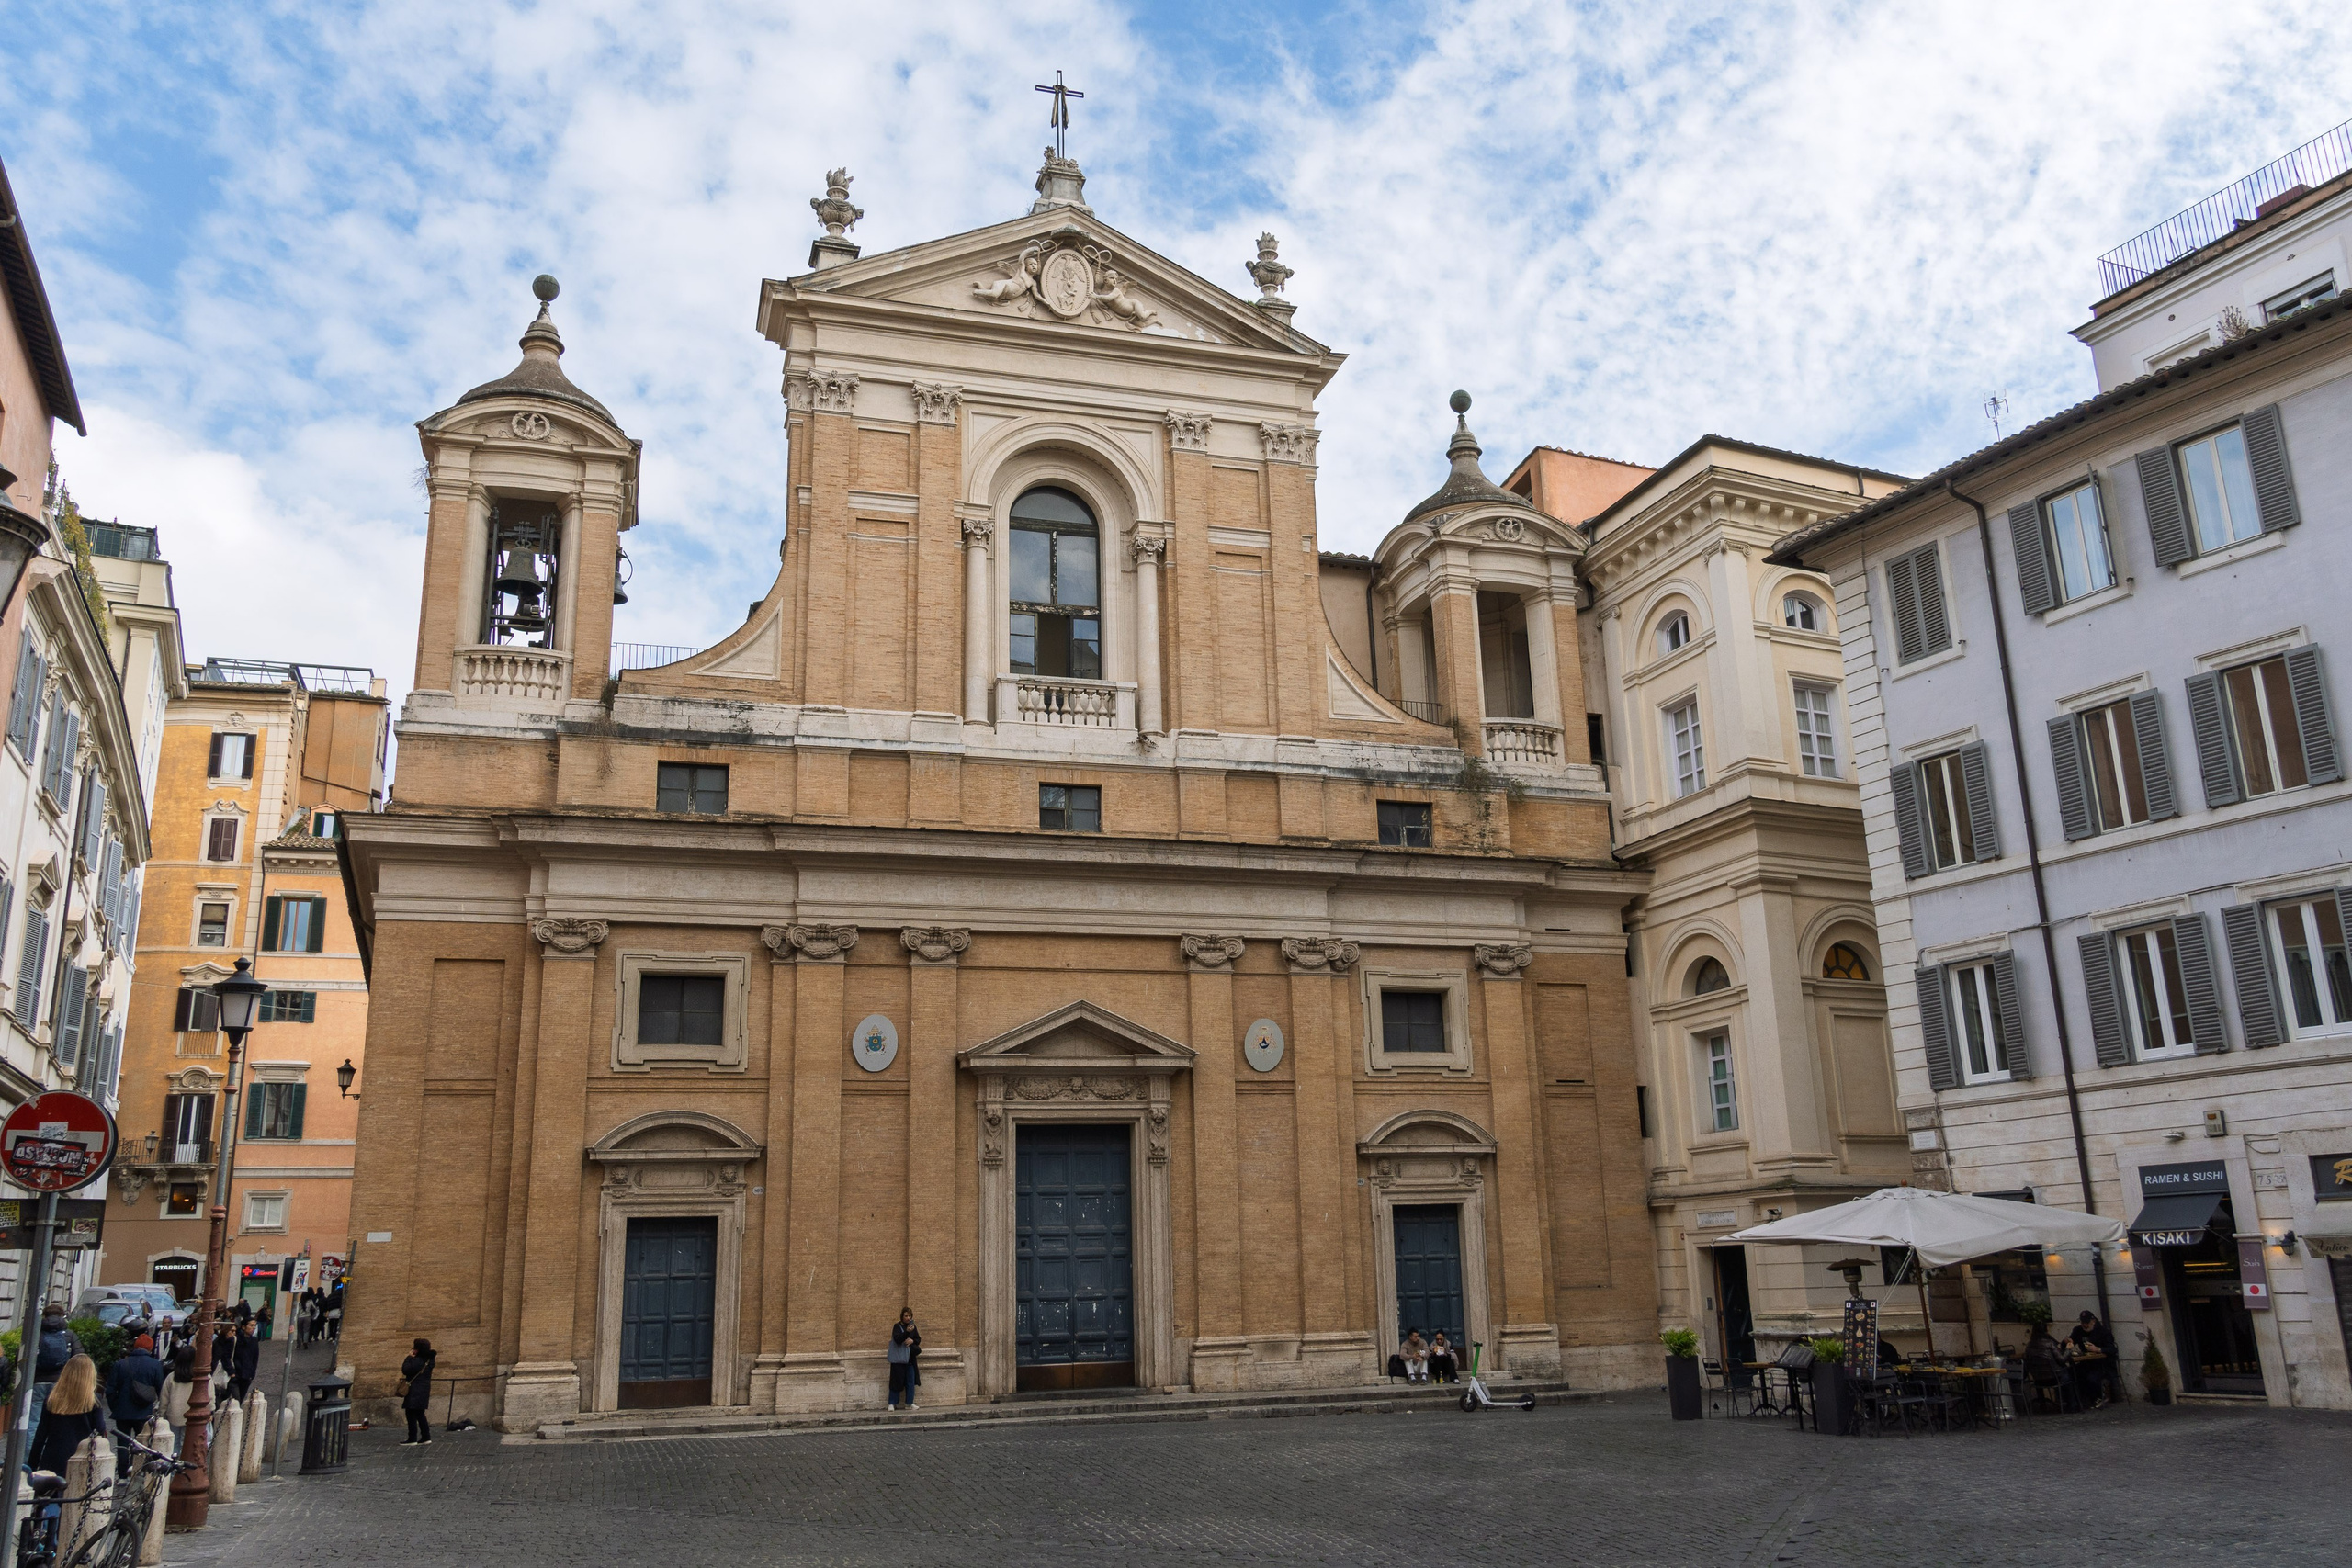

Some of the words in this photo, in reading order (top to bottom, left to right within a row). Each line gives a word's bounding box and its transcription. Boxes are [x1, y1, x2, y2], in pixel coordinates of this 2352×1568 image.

[2144, 1174, 2180, 1185] RAMEN
[2182, 1173, 2190, 1182] &
[2192, 1170, 2223, 1181] SUSHI
[2142, 1232, 2190, 1245] KISAKI
